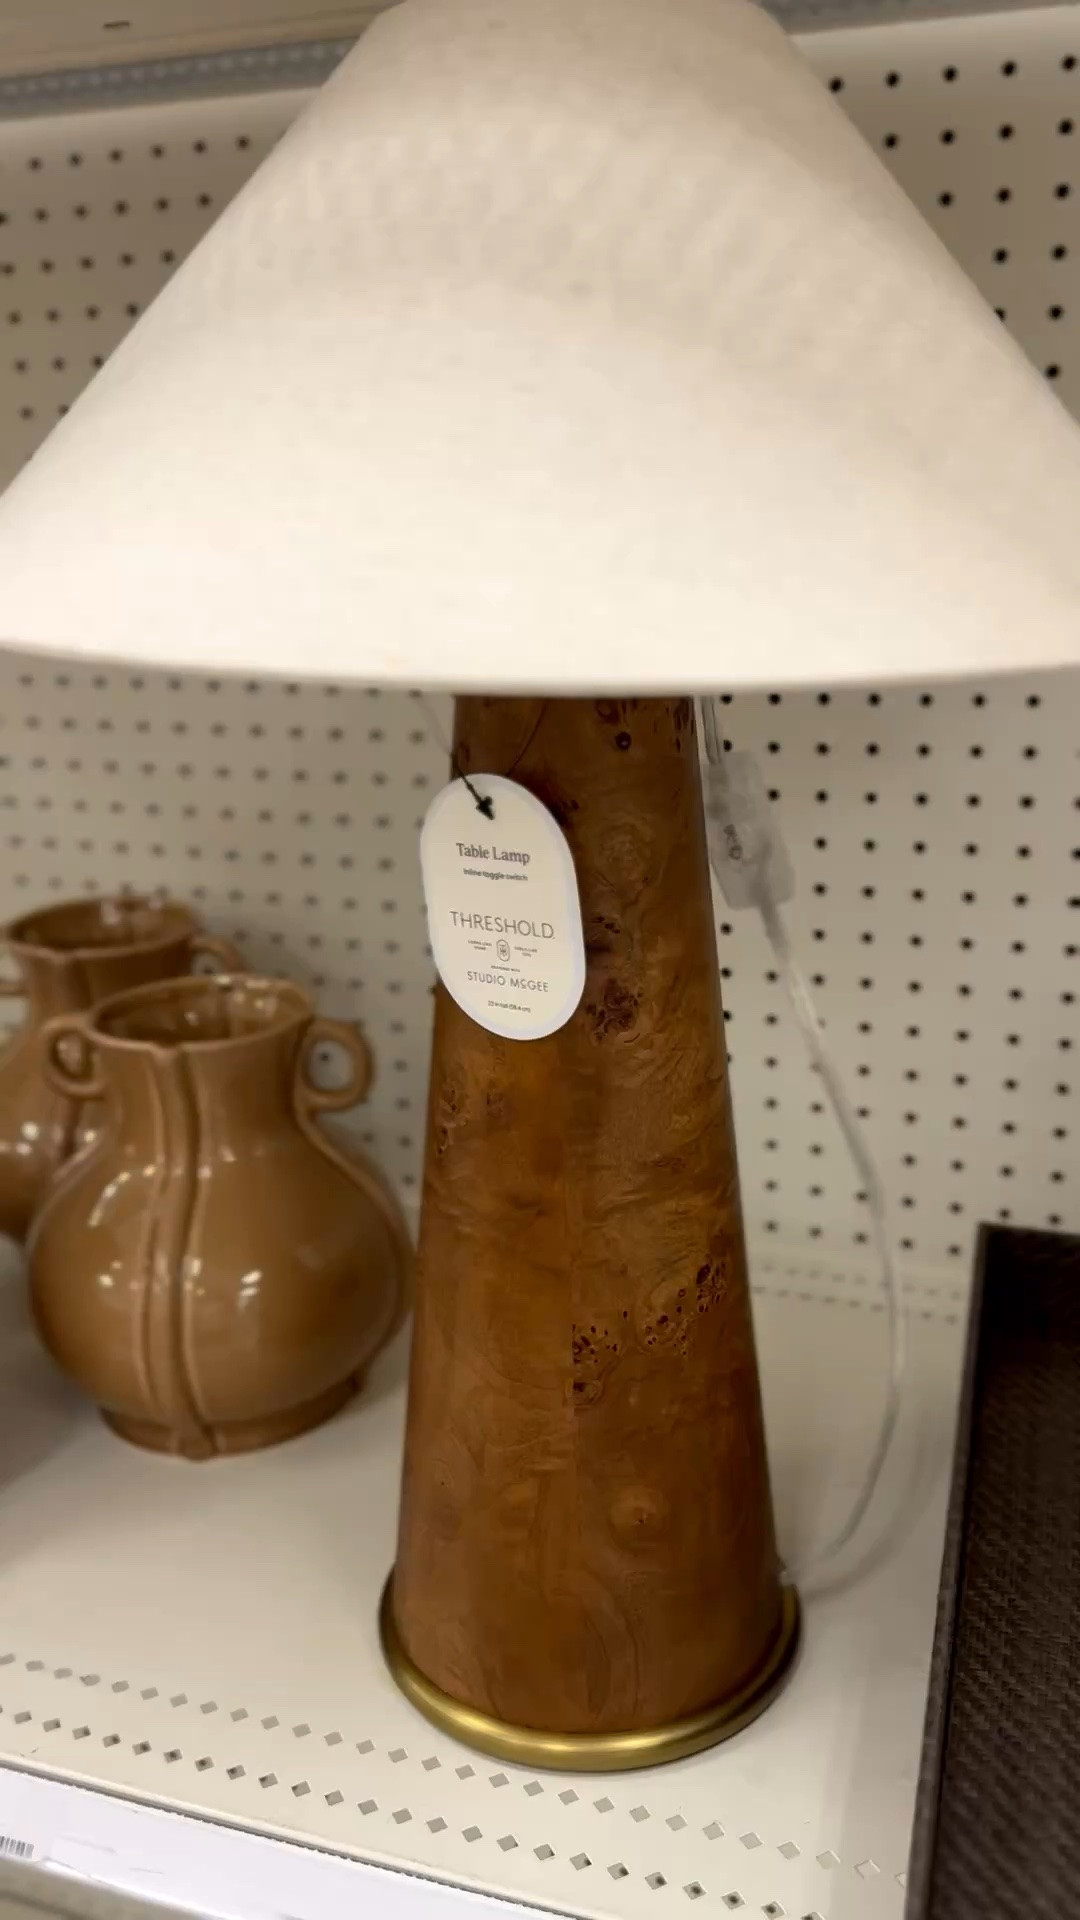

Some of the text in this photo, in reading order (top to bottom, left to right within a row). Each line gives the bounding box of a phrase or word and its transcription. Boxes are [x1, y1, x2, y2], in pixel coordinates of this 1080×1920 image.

[456, 843, 530, 866] Table Lamp
[482, 871, 504, 880] toggle
[450, 911, 554, 939] THRESHOLD
[467, 971, 505, 986] STUDIO
